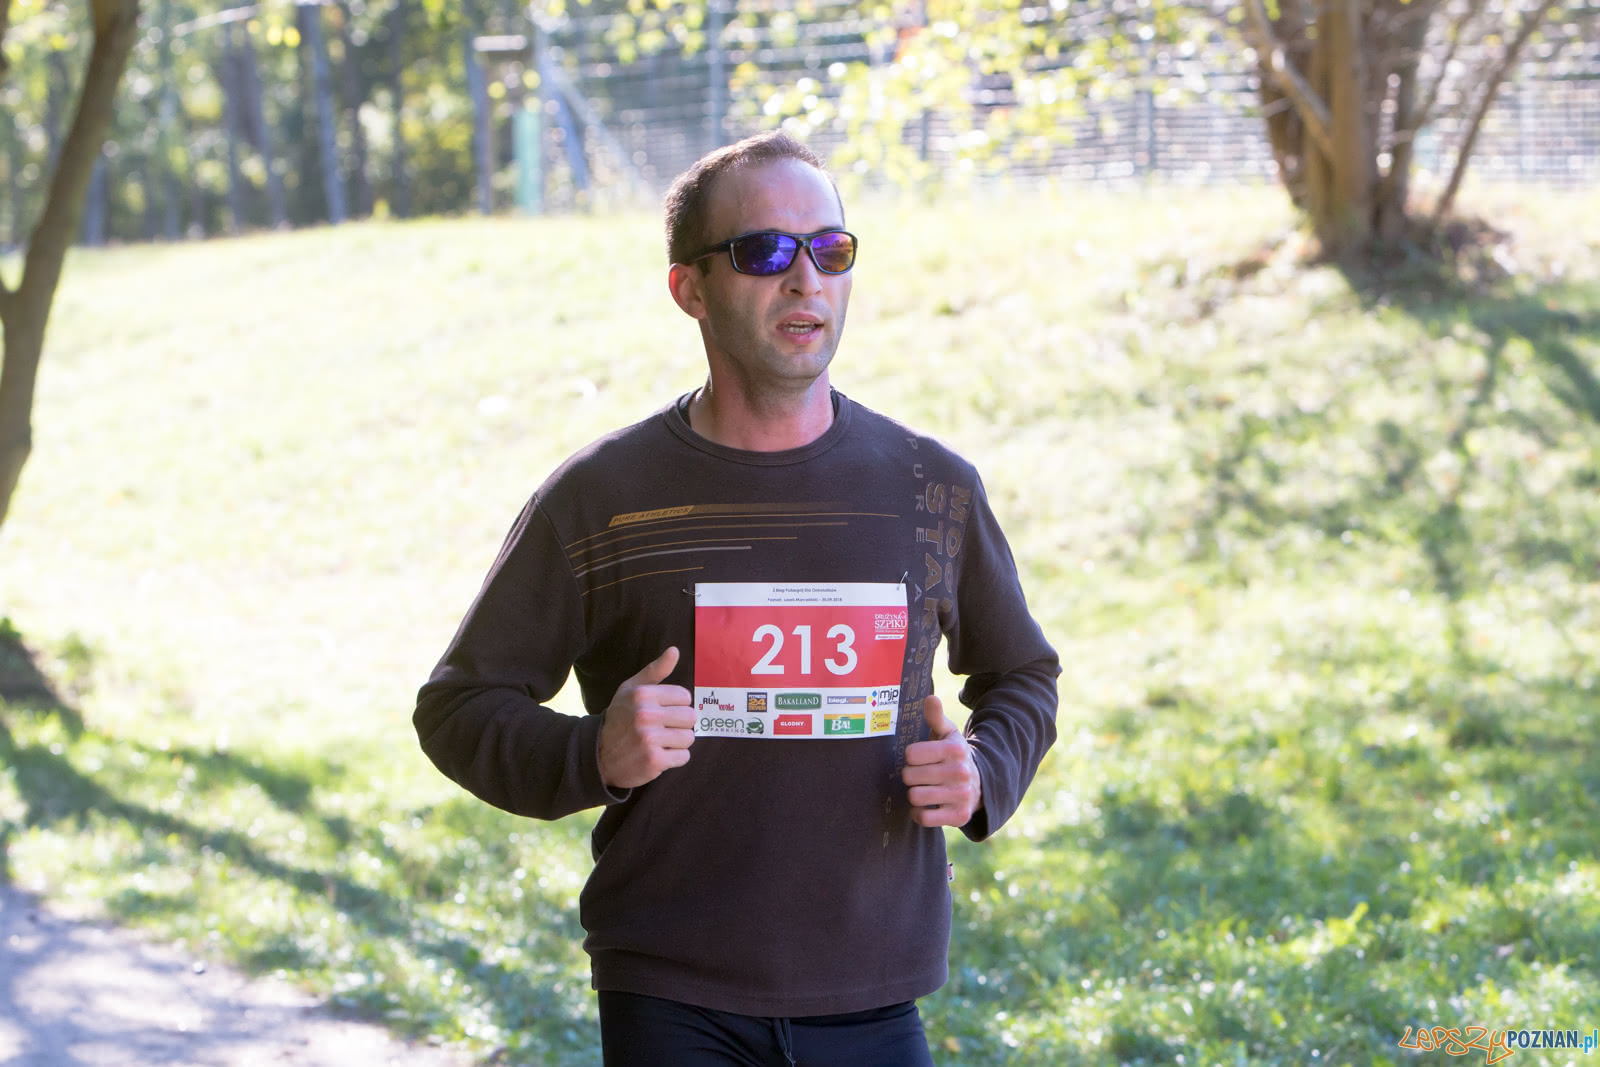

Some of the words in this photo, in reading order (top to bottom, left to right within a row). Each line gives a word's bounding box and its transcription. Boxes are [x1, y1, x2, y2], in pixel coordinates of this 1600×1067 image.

[613, 514, 637, 524] PURE
[639, 507, 690, 520] ATHLETICS
[874, 620, 907, 628] SZPIKU
[750, 623, 858, 676] 213
[778, 695, 820, 706] BAKALLAND
[880, 688, 898, 701] mjp
[700, 717, 745, 732] green
